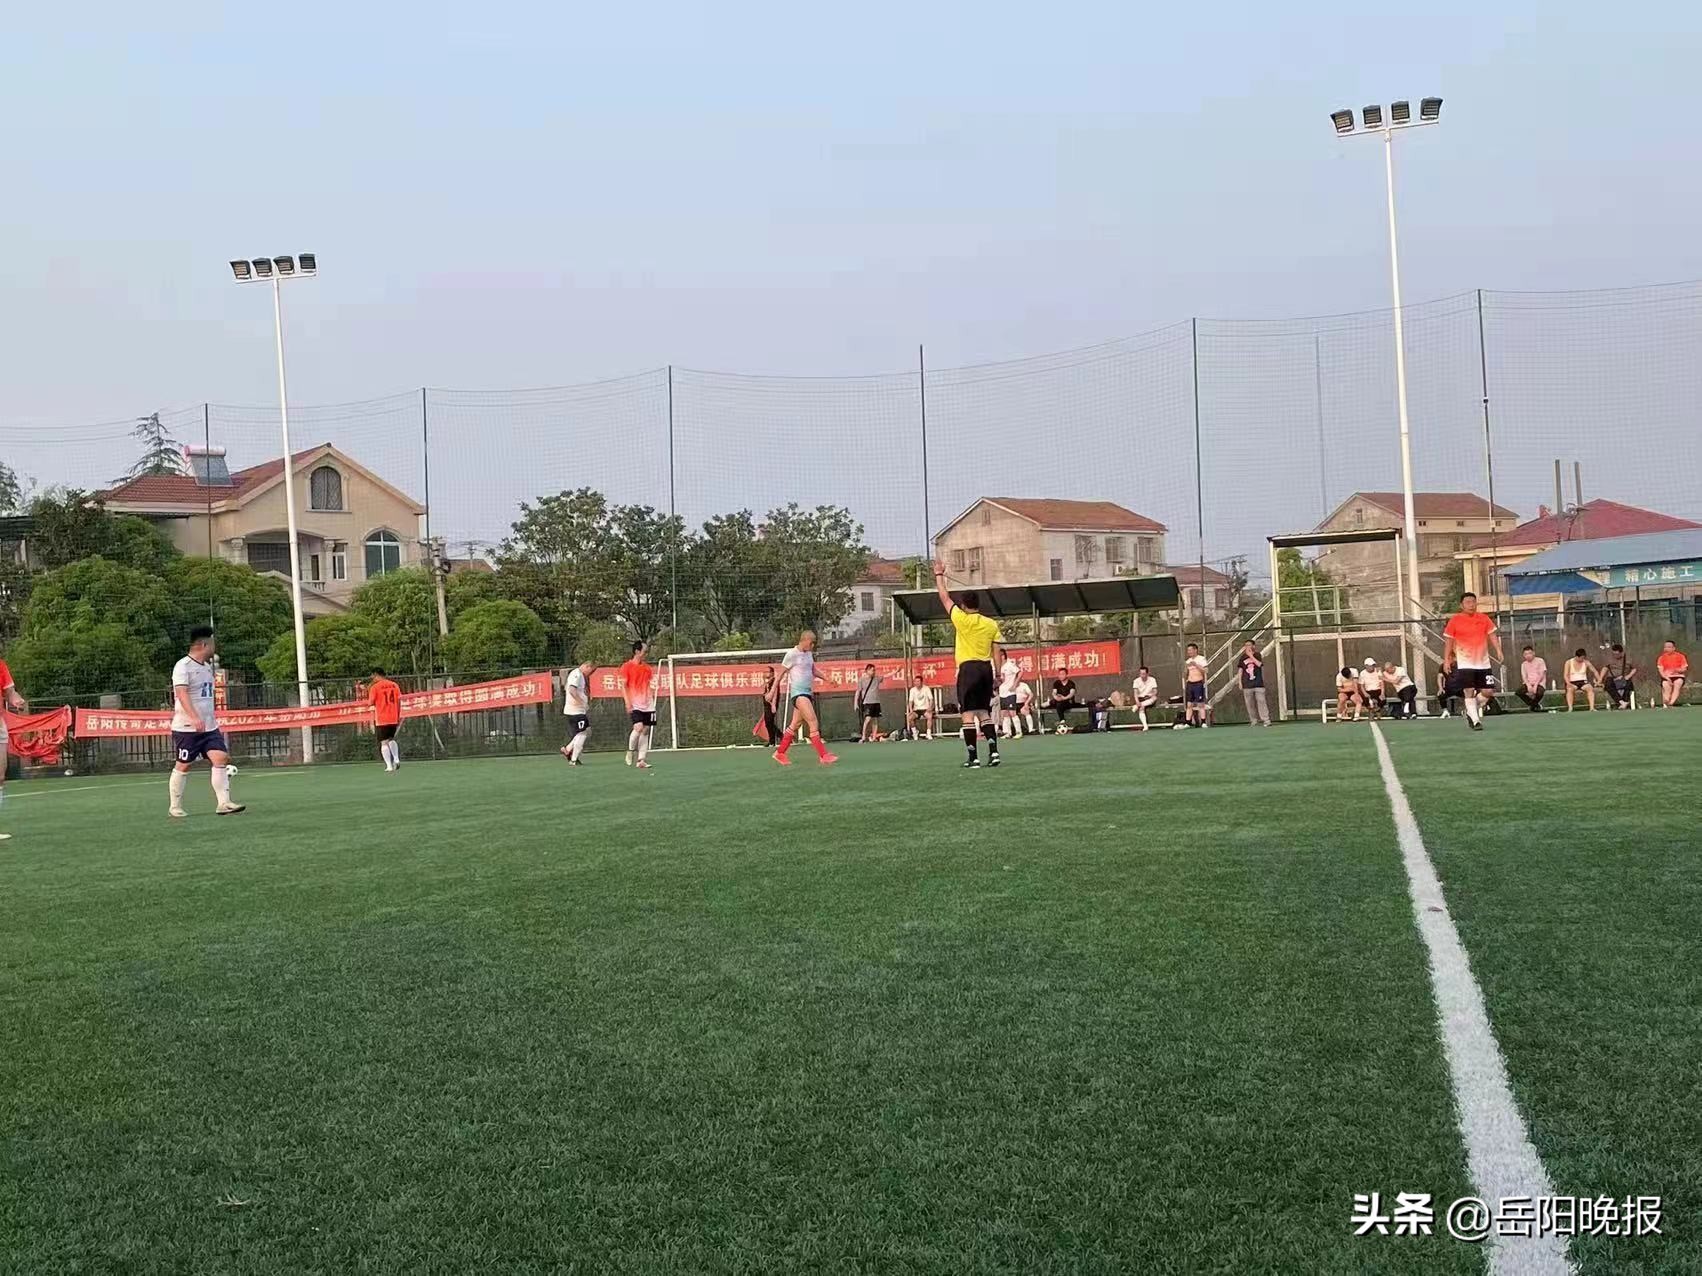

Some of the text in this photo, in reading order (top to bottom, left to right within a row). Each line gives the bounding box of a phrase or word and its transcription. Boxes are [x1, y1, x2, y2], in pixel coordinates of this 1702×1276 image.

[1624, 565, 1695, 583] 精心施工
[383, 690, 395, 705] 14
[178, 748, 189, 761] 10
